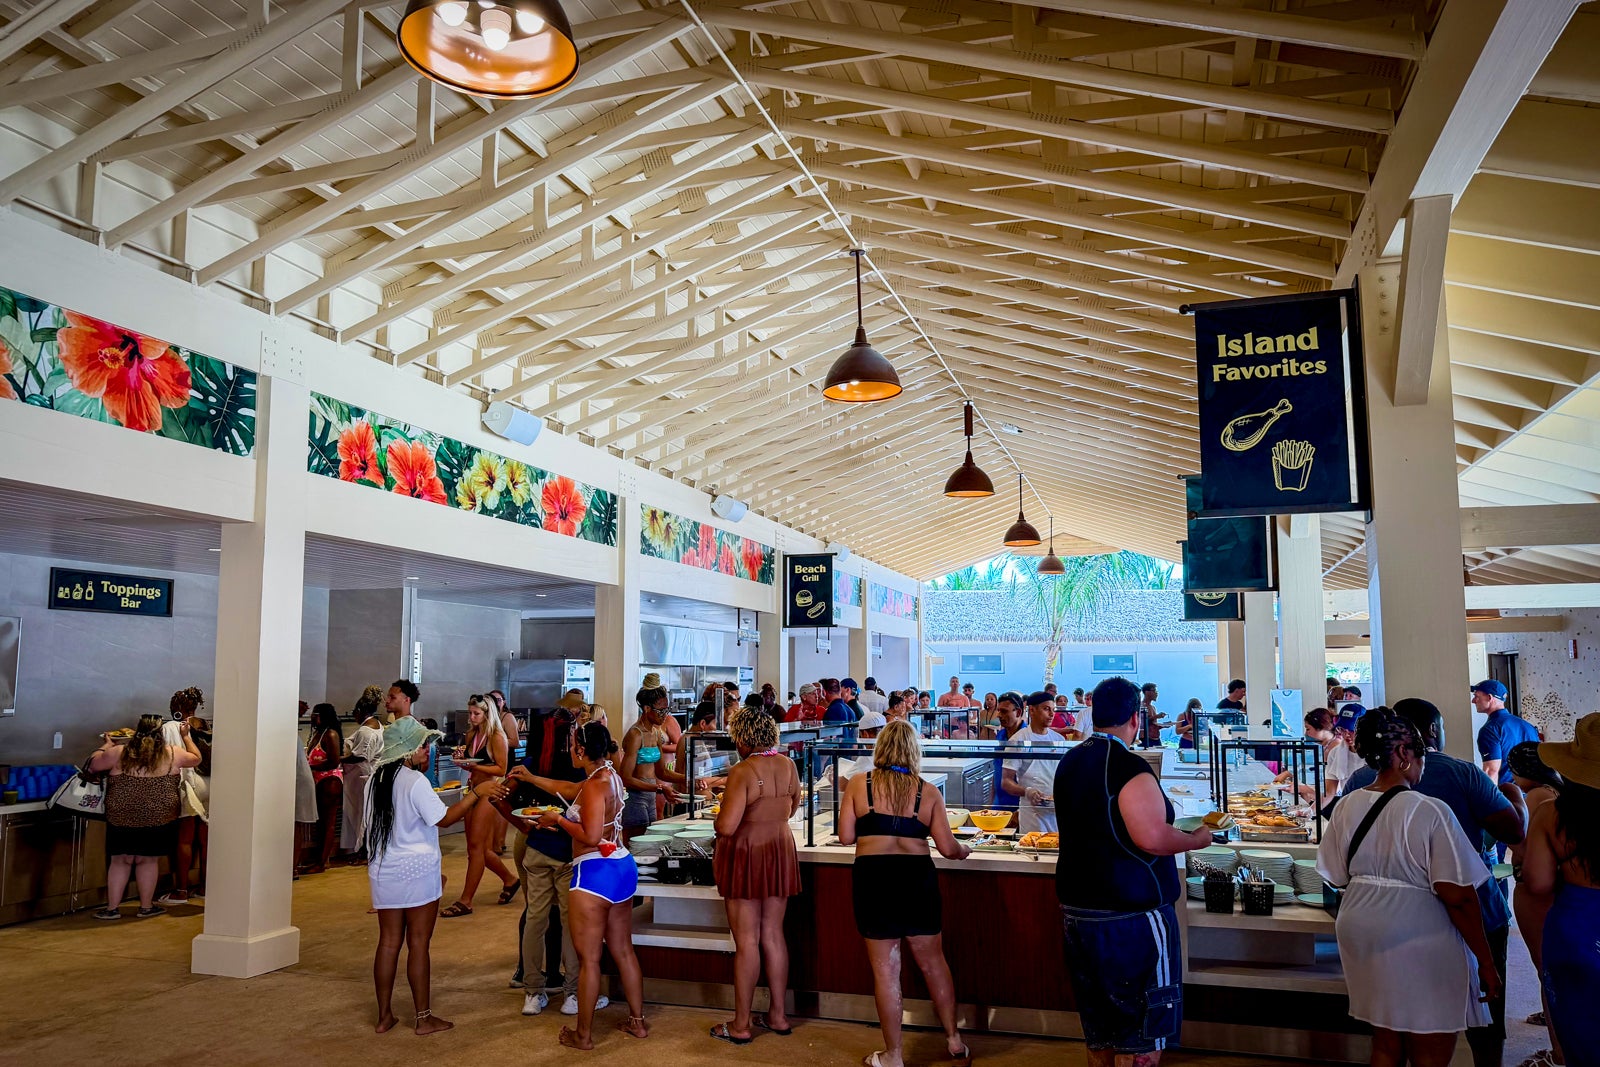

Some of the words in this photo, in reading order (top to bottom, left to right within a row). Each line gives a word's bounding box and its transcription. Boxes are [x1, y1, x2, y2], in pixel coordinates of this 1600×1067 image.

[1217, 326, 1319, 357] Island
[1213, 358, 1327, 381] Favorites
[795, 564, 826, 574] Beach
[101, 580, 161, 599] Toppings
[121, 597, 141, 608] Bar
